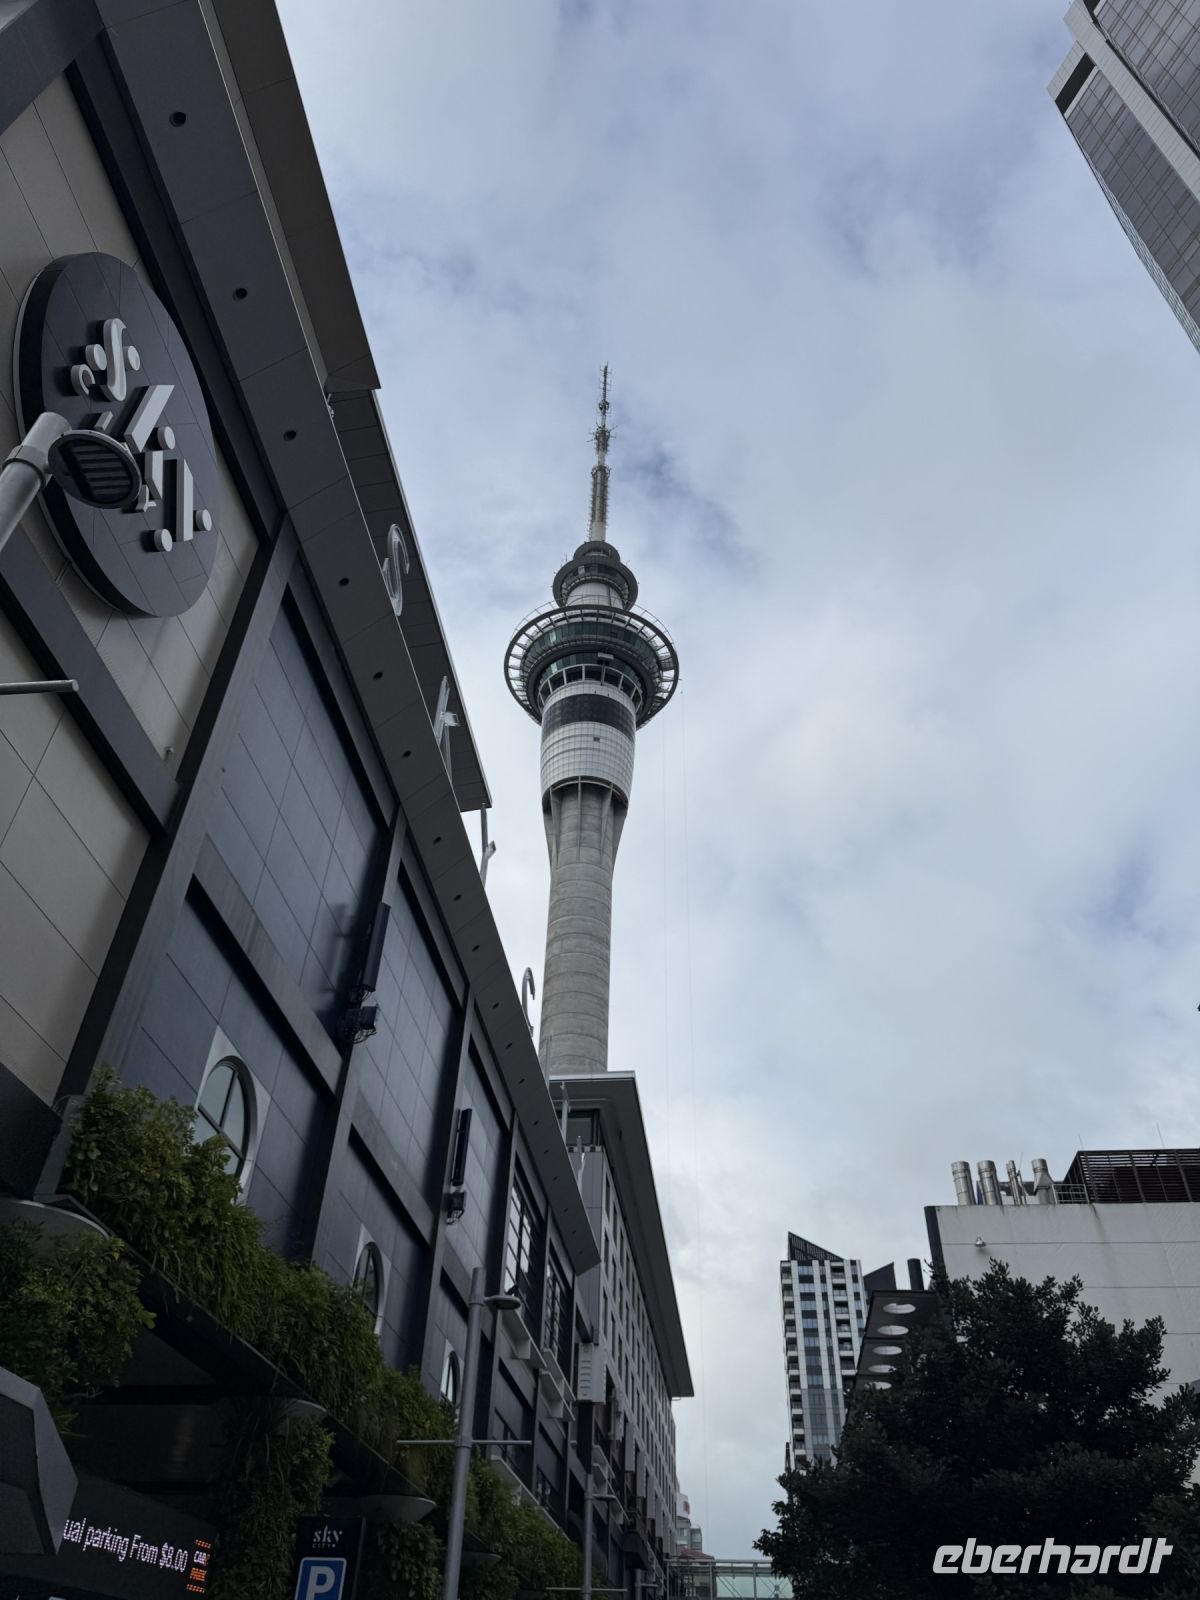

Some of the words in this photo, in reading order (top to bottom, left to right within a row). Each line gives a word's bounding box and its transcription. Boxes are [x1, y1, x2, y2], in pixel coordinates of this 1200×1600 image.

[82, 1525, 130, 1562] parking
[129, 1533, 159, 1565] From
[158, 1541, 189, 1573] $8.00
